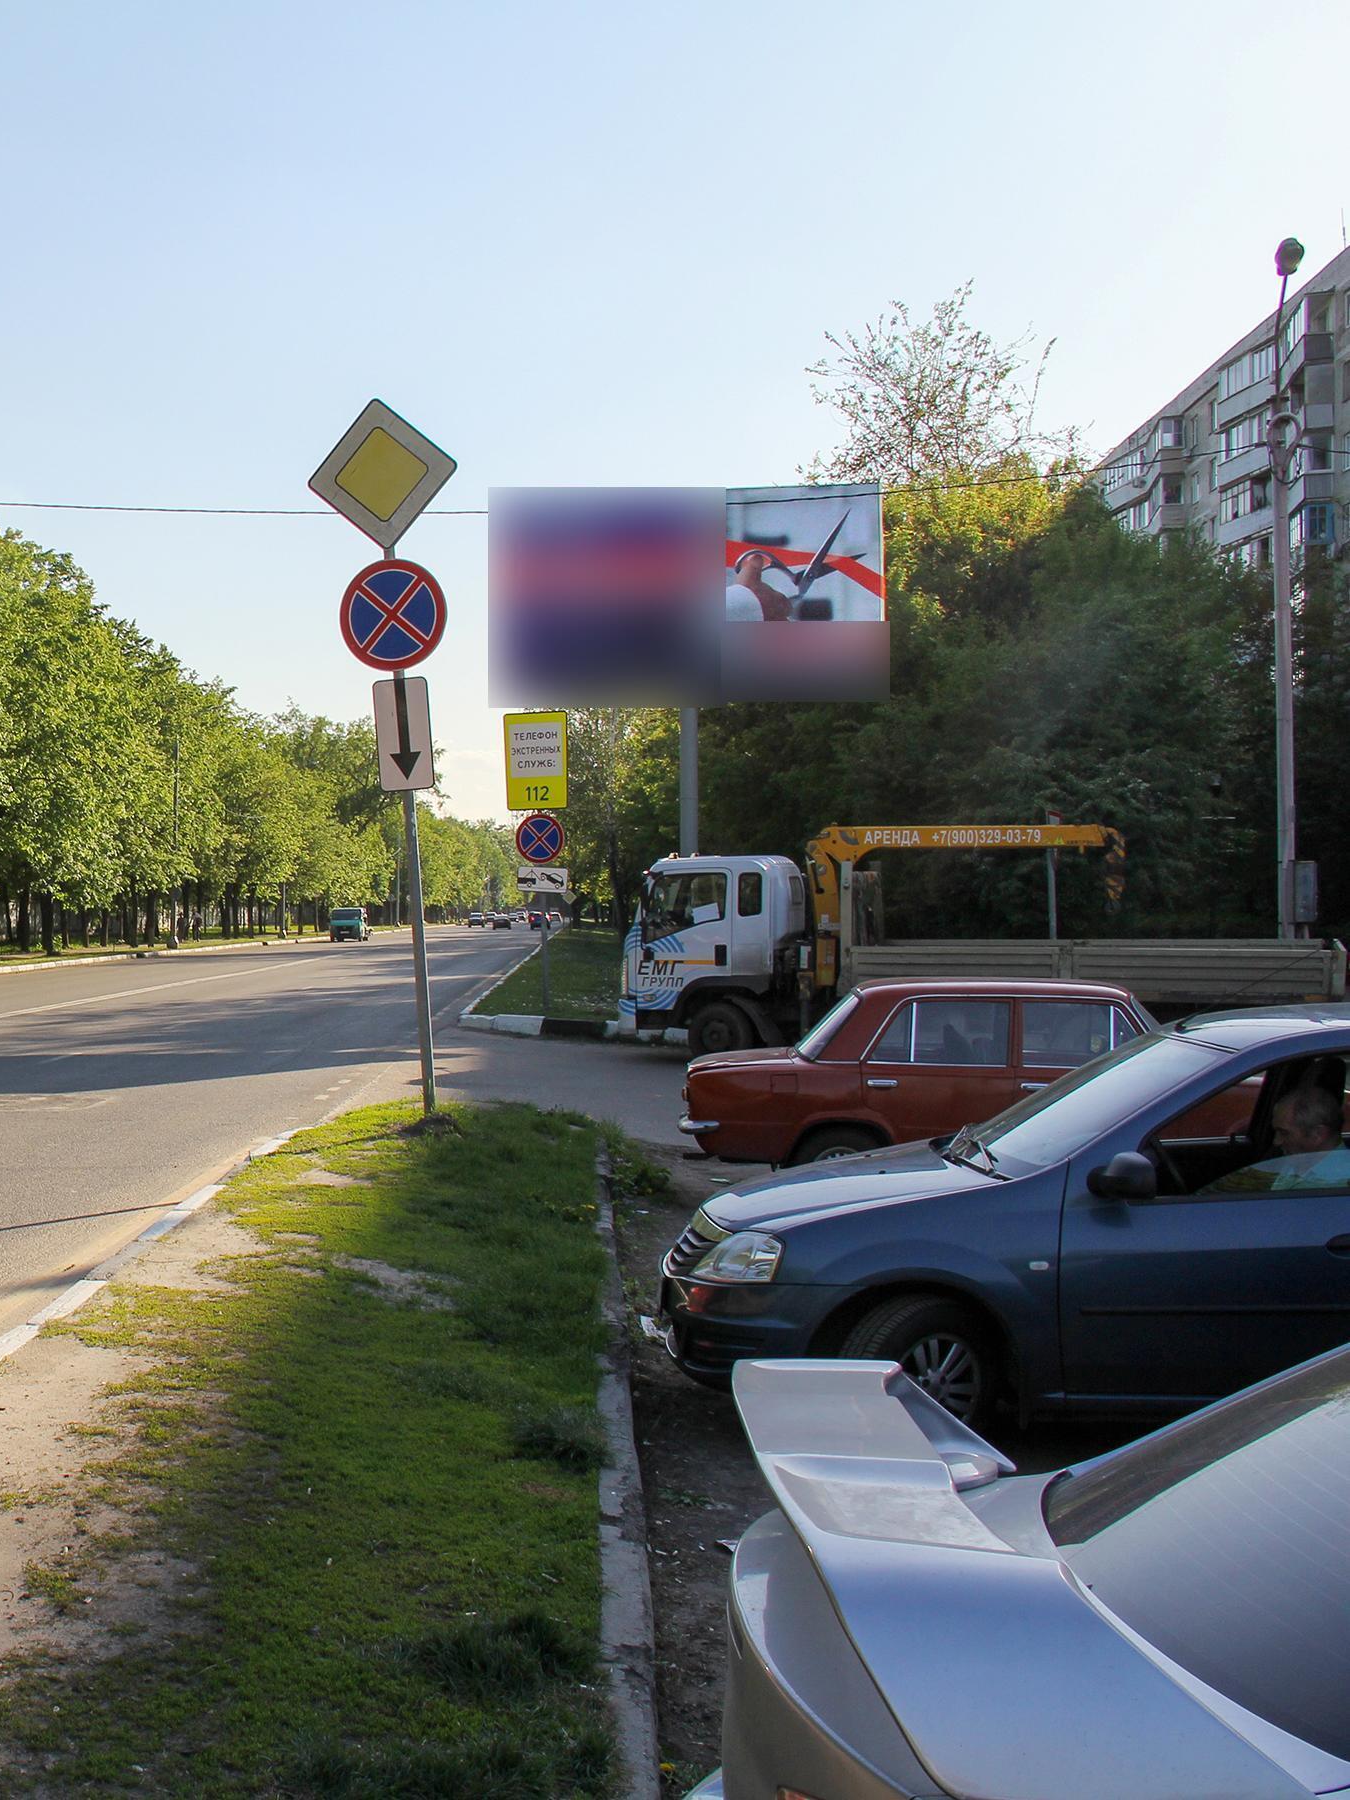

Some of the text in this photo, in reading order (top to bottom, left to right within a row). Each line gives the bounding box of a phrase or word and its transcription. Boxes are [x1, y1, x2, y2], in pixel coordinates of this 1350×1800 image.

[514, 731, 558, 741] ТЕЛЕФОН
[511, 745, 561, 756] ЭКСТРЕННЫХ
[517, 759, 556, 769] СЛУЖБ:
[525, 786, 549, 801] 112
[864, 829, 1041, 847] АРЕНДА +7(900)329-03-79
[638, 960, 683, 976] ЕМГ
[642, 977, 684, 987] ГРУПП
